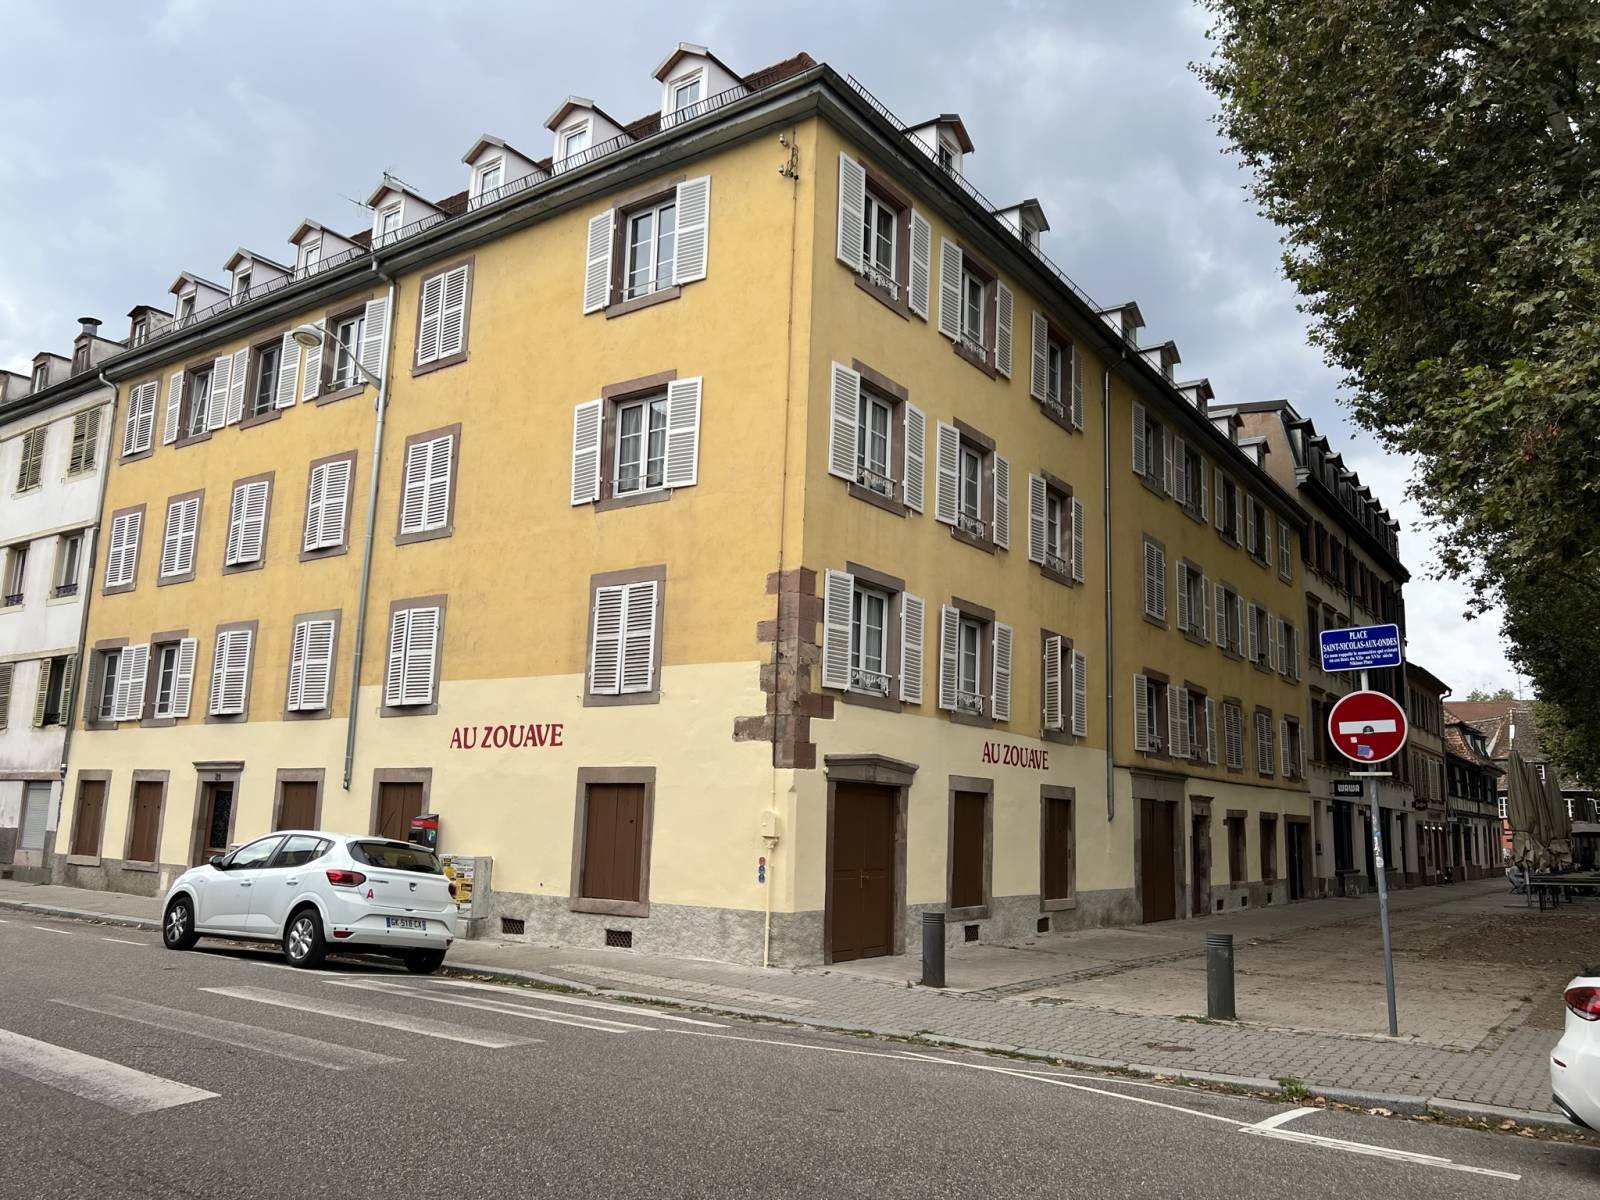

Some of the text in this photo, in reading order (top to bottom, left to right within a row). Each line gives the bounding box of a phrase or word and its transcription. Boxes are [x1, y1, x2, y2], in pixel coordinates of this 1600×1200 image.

[1349, 630, 1368, 640] PLACE
[1322, 637, 1398, 652] SAINT-NICOLAS-AUX-ONDES
[449, 723, 564, 750] AU ZOUAVE
[982, 741, 1049, 770] AU ZOUAVE
[1337, 783, 1360, 793] WAWA
[366, 888, 374, 899] A
